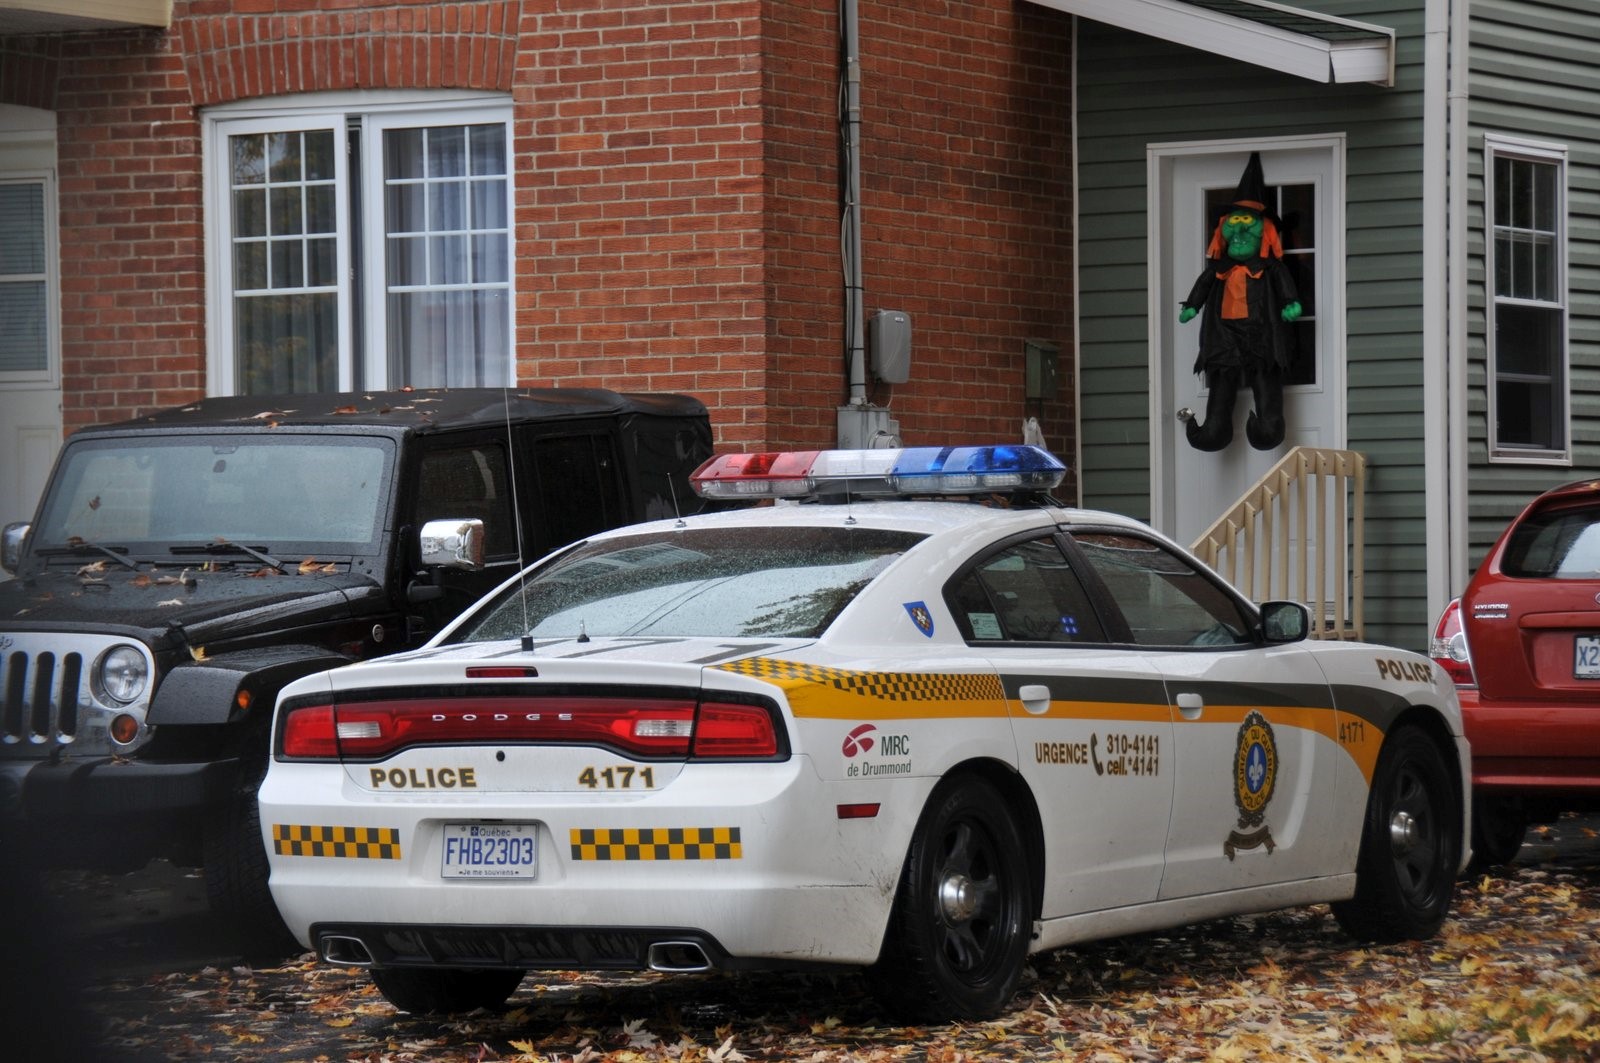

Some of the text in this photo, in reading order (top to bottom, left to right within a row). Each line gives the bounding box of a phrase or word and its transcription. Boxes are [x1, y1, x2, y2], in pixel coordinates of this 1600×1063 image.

[432, 713, 573, 721] DODGE
[1338, 721, 1365, 743] 4171
[880, 734, 910, 756] MRC
[1035, 742, 1088, 764] URGENCE
[1106, 733, 1160, 755] 310-4141
[369, 767, 478, 788] POLICE
[578, 766, 654, 788] 4171
[847, 759, 912, 777] de Drummond
[480, 826, 511, 837] Québec
[446, 837, 533, 865] FHB2303
